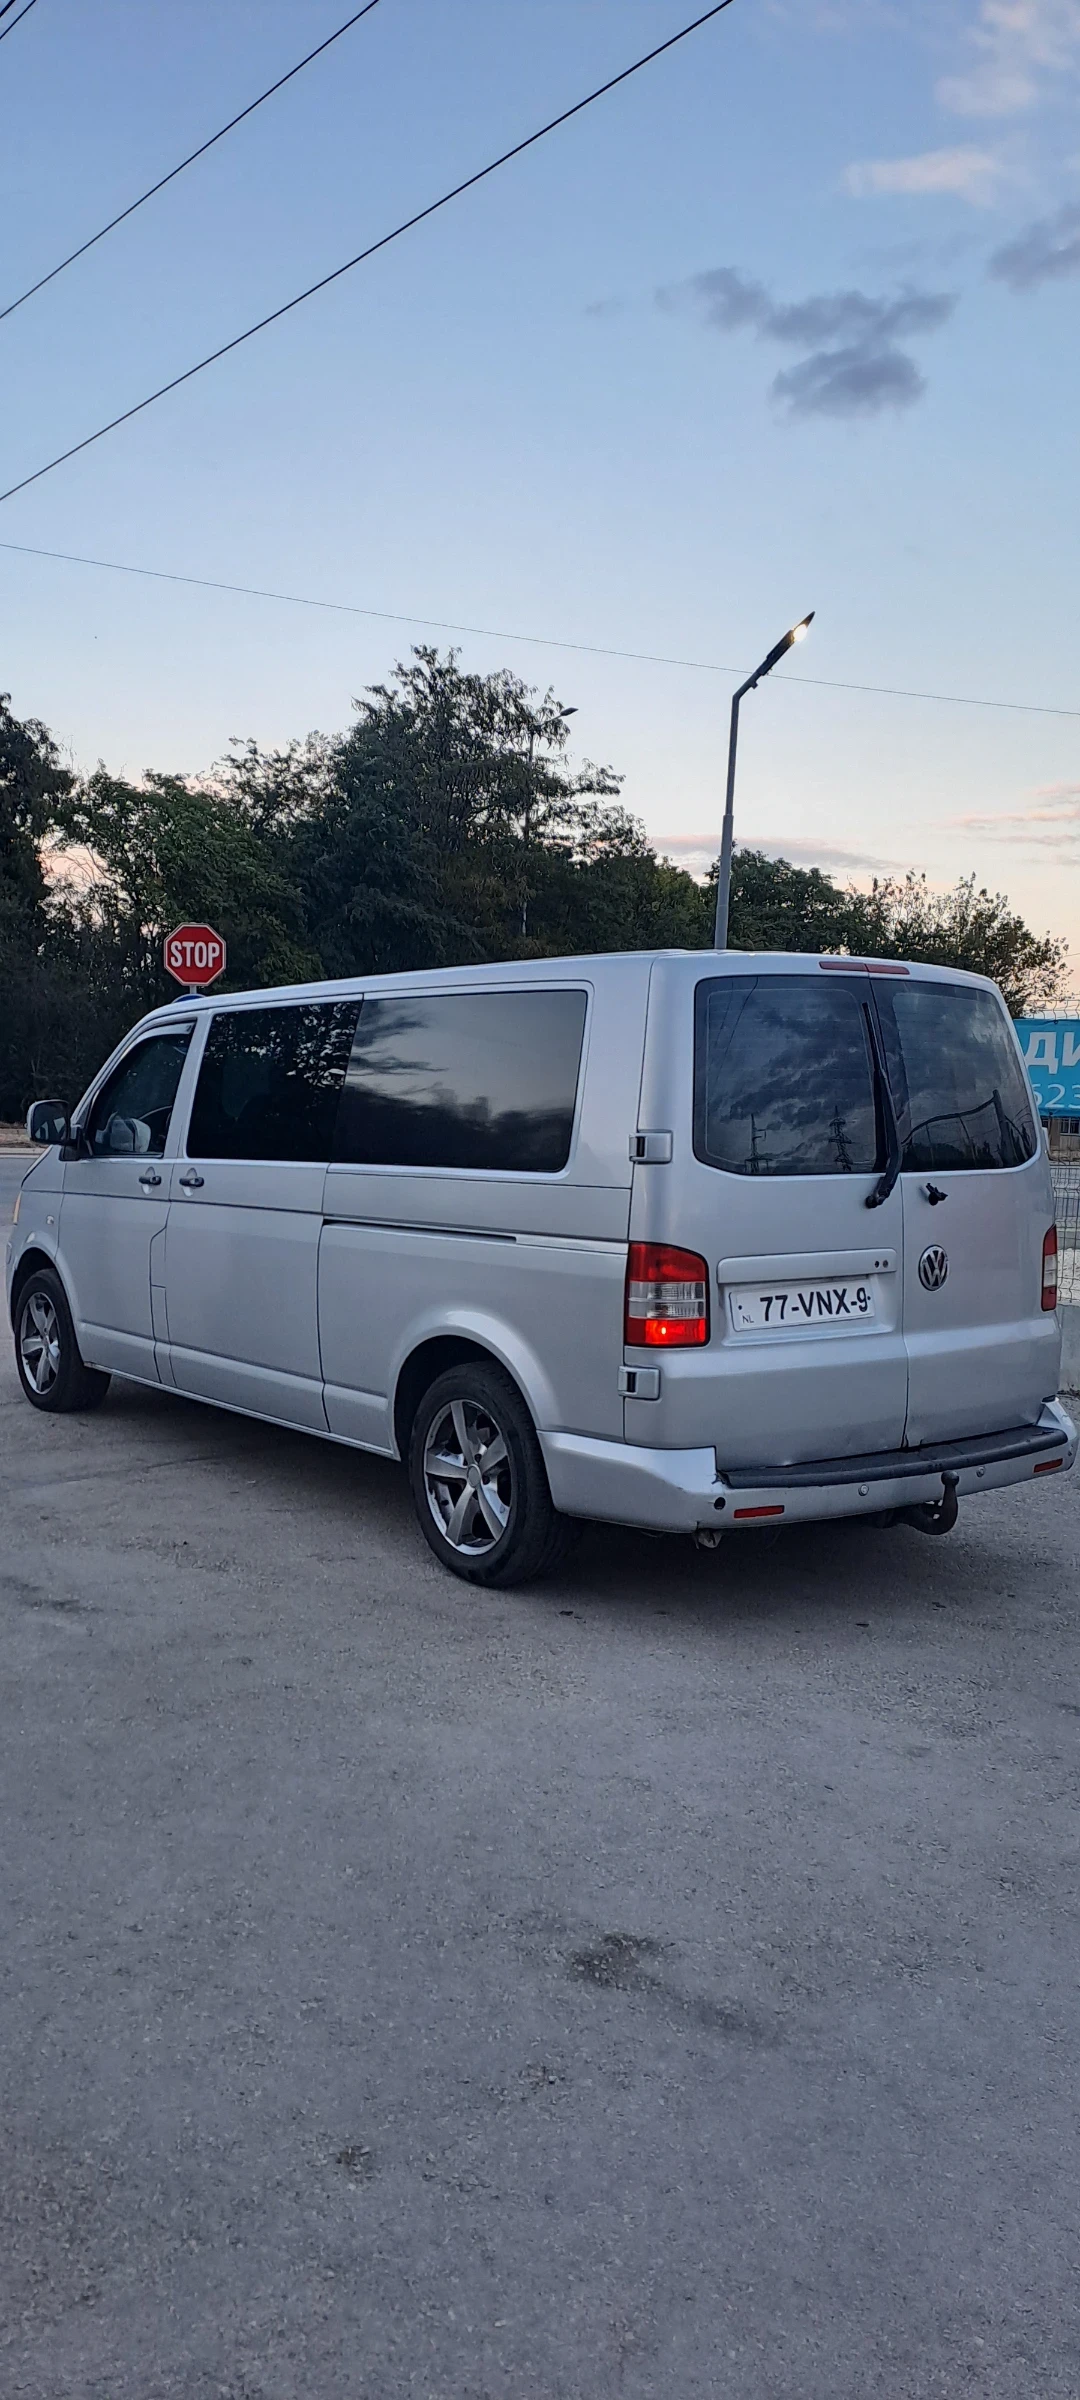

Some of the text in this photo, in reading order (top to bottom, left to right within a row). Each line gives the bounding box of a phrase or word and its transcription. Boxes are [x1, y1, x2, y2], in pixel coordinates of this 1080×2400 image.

[170, 941, 220, 968] STOP
[759, 1287, 868, 1322] 77-VNX-9
[742, 1314, 755, 1324] NL
